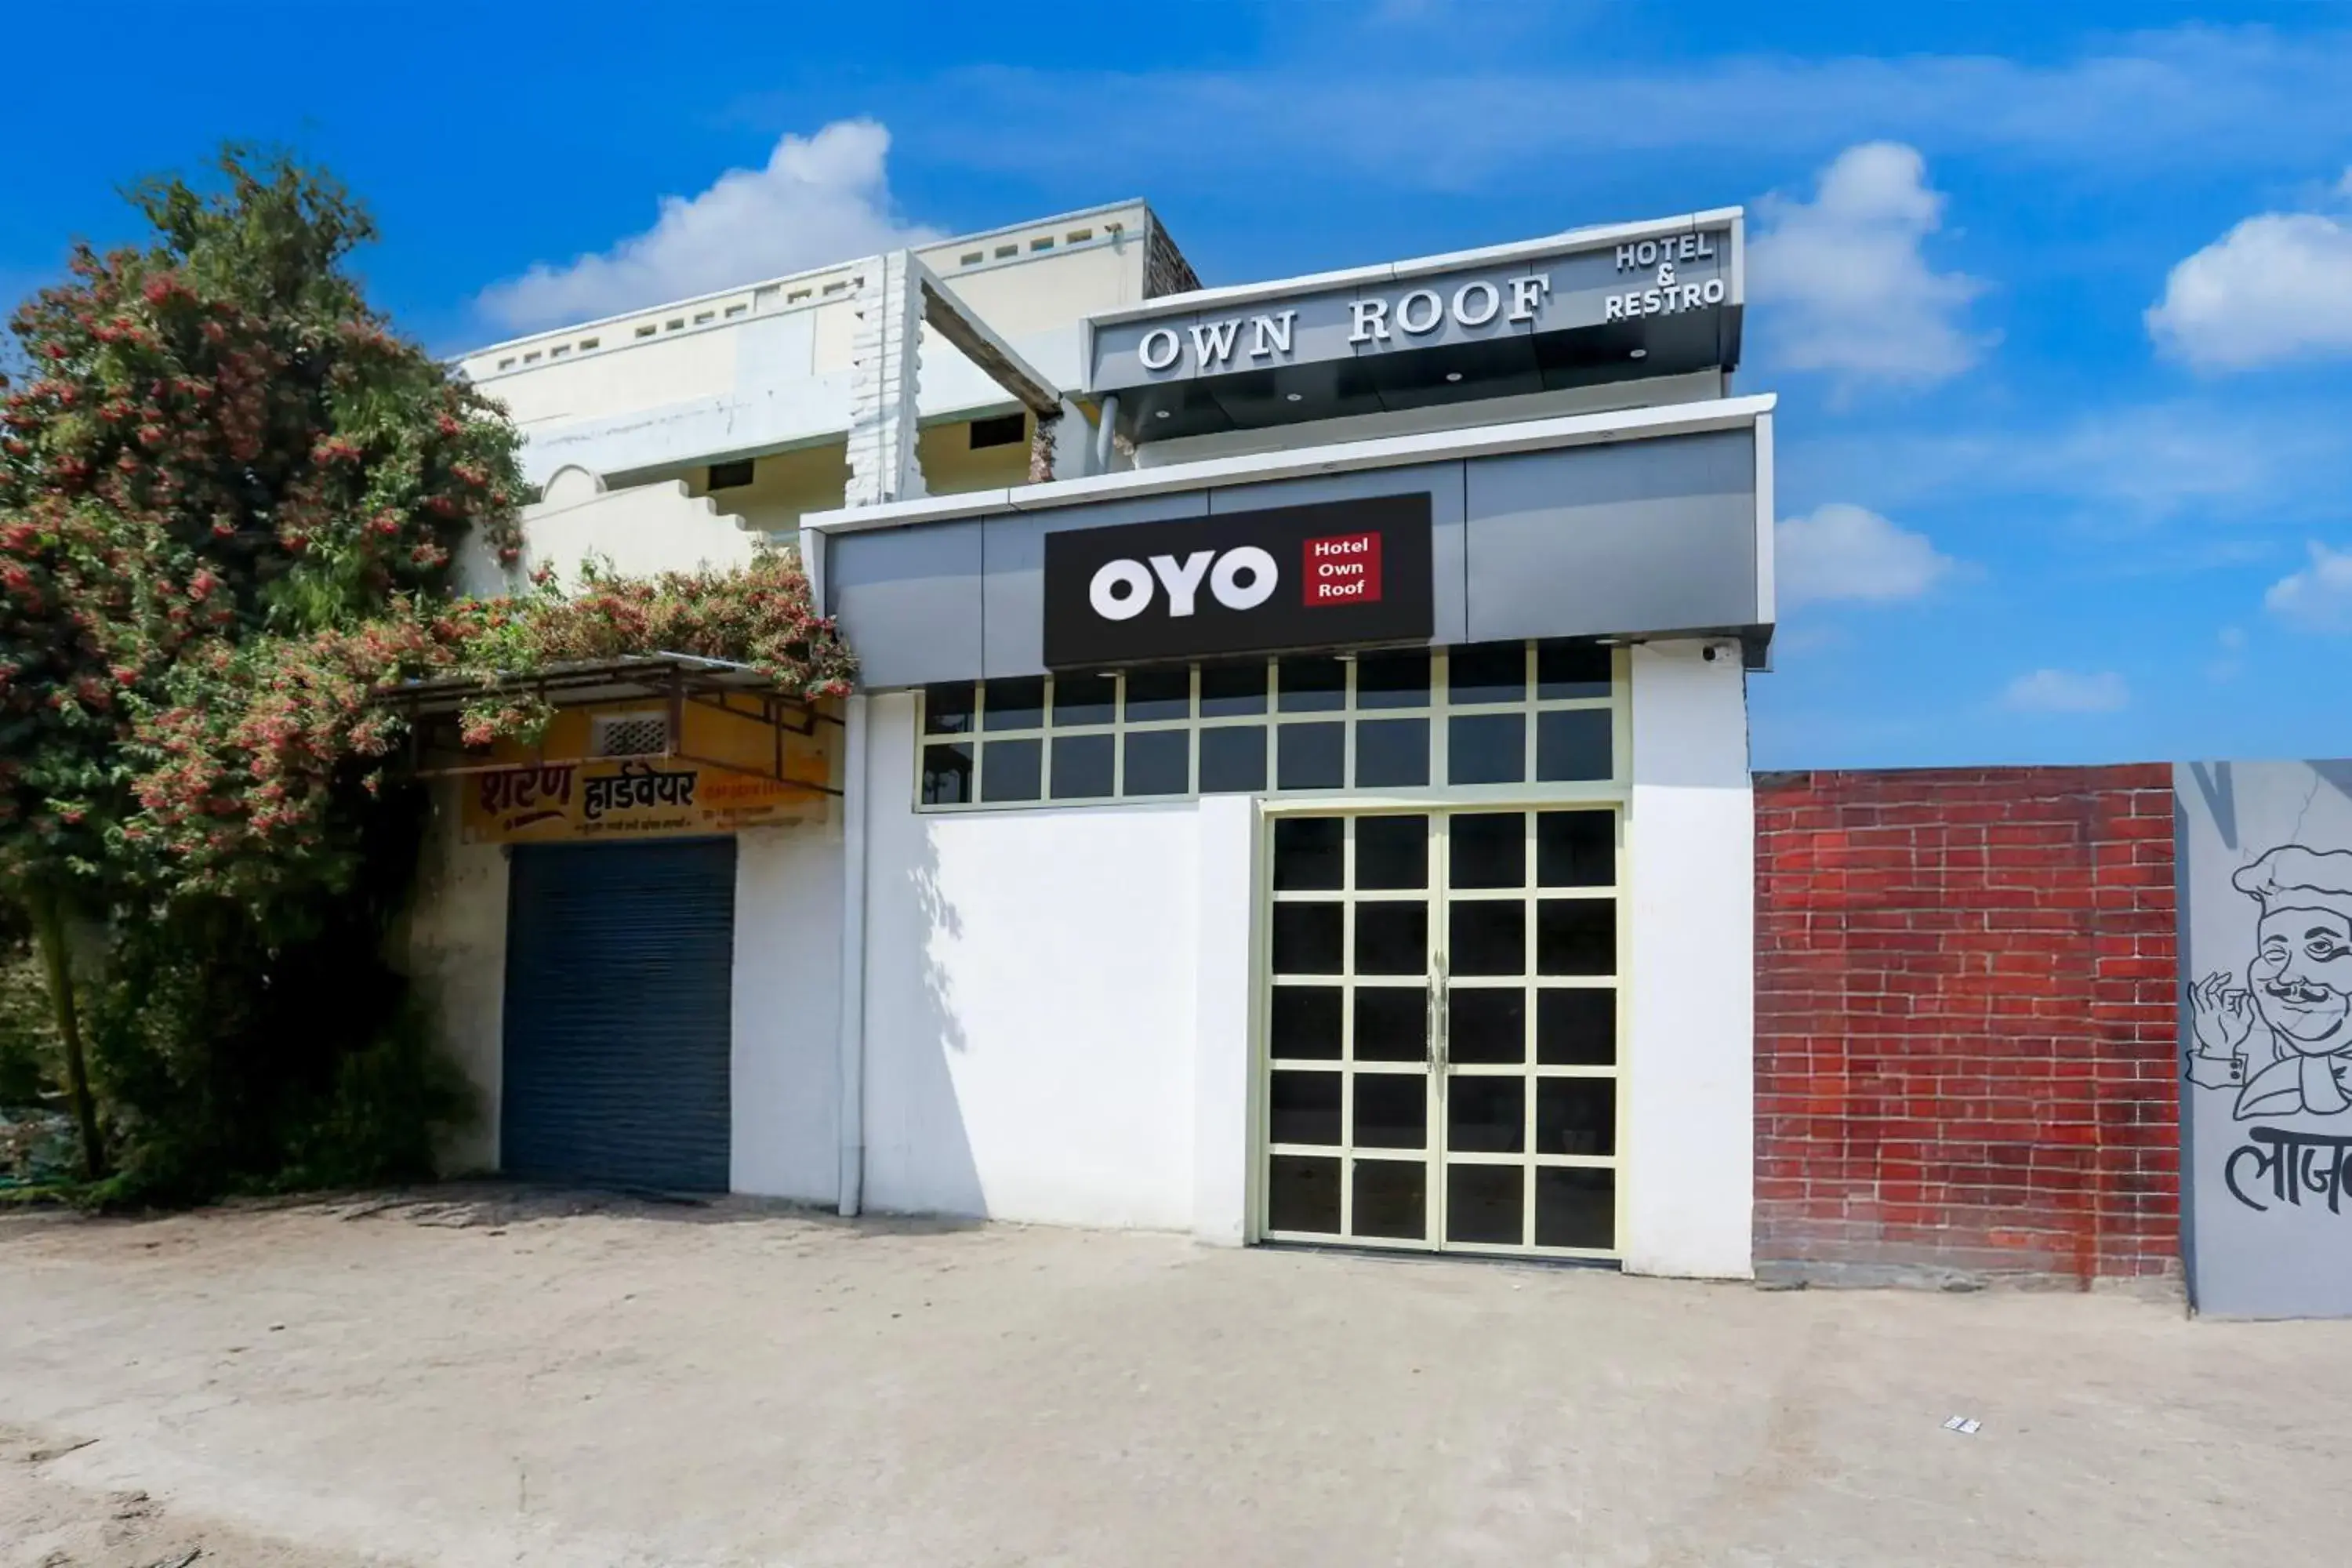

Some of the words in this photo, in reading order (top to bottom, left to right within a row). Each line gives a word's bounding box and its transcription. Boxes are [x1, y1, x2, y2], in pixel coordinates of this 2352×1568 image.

[1616, 233, 1714, 272] HOTEL
[1656, 263, 1676, 289] &
[1605, 278, 1726, 320] RESTRO
[1138, 310, 1298, 371] OWN
[1348, 274, 1551, 343] ROOF
[1315, 538, 1369, 557] Hotel
[1089, 546, 1279, 621] OYO
[1318, 561, 1364, 578] Own
[1318, 579, 1366, 598] Roof
[583, 760, 698, 819] हार्डवेयर
